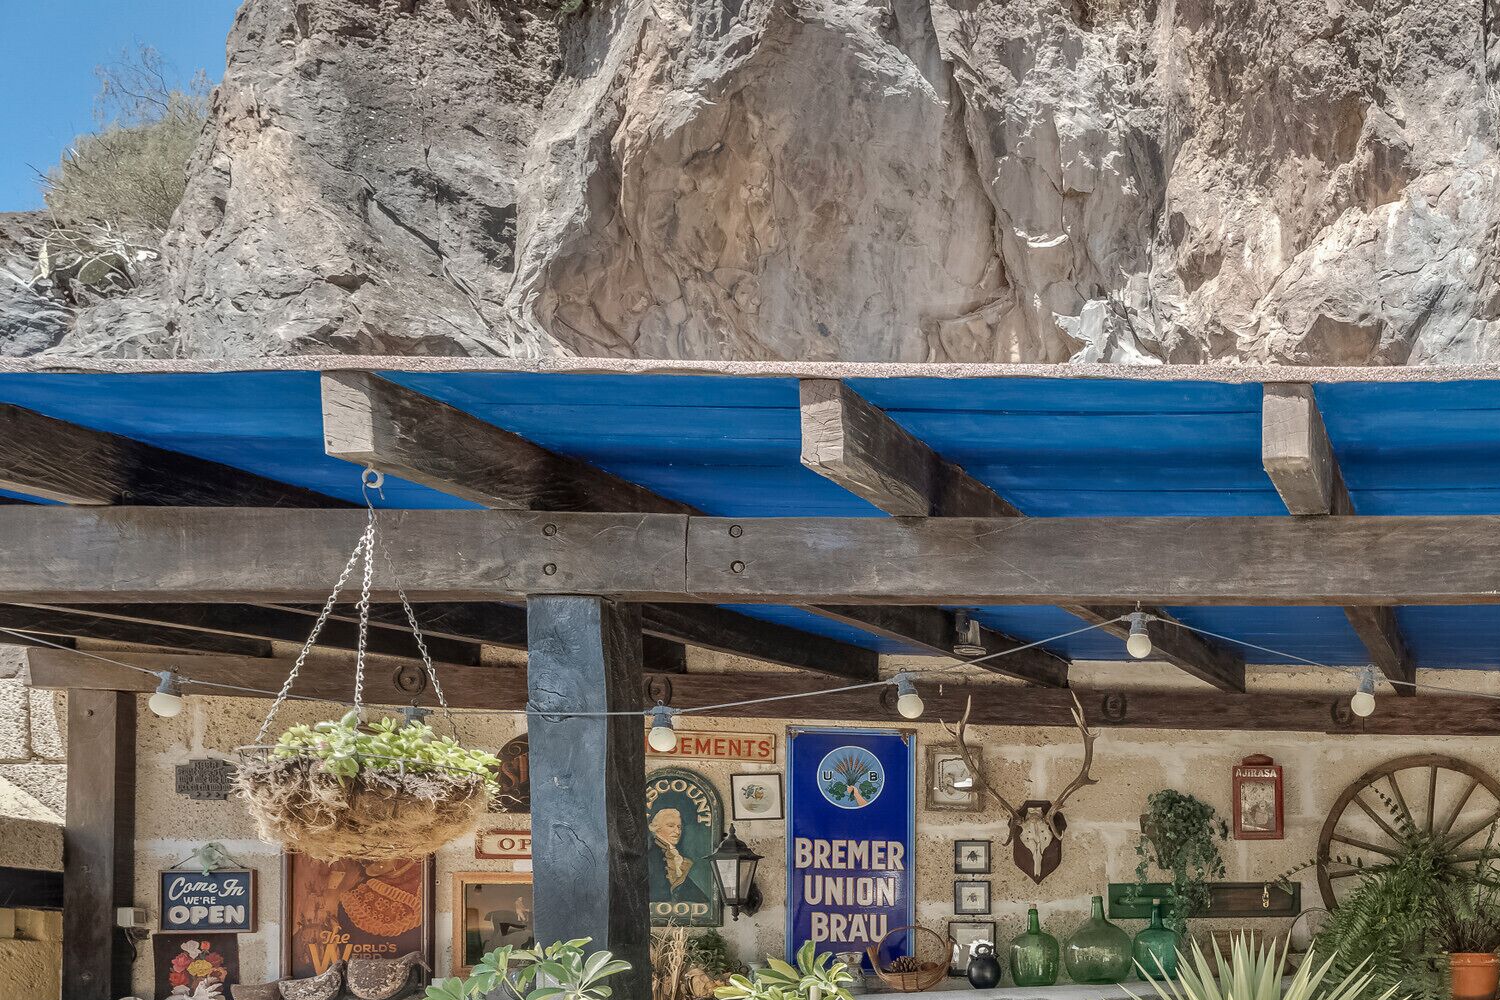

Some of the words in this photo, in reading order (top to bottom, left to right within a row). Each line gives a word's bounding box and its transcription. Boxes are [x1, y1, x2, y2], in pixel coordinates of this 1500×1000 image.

[644, 736, 770, 758] EMENTS
[646, 779, 711, 827] SCOUNT
[795, 837, 905, 870] BREMER
[168, 877, 218, 900] Come
[218, 879, 245, 897] In
[804, 875, 895, 907] UNION
[183, 896, 216, 905] WE'RE
[168, 905, 245, 925] OPEN
[320, 922, 351, 944] The
[811, 911, 888, 943] BRÄU
